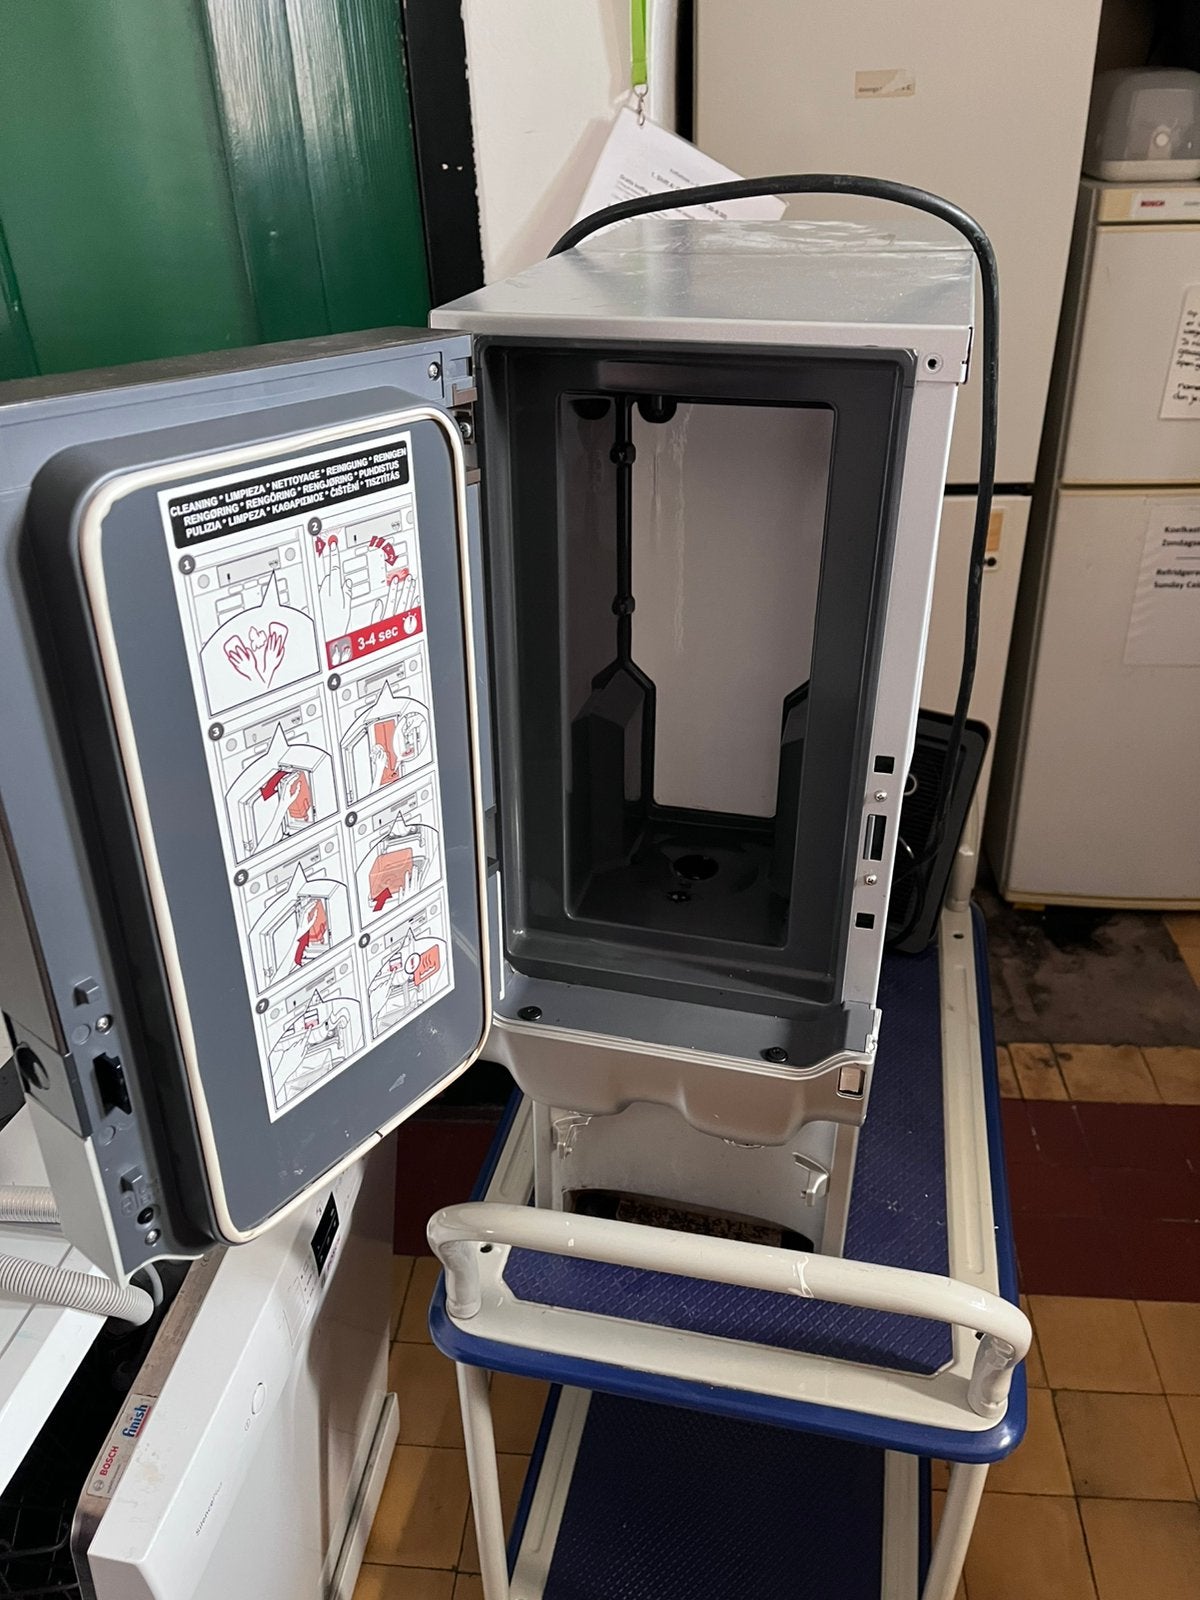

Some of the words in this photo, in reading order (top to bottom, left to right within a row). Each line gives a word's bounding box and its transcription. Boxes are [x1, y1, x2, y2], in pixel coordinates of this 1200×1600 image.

[170, 496, 219, 517] CLEANING
[224, 483, 266, 503] LIMPIEZA
[271, 469, 321, 491] NETTOYAGE
[326, 457, 368, 476] REINIGUNG
[373, 447, 407, 464] REINIGEN
[183, 503, 239, 527] RENGØRING
[245, 487, 297, 510] RENGÖRING
[302, 472, 354, 494] RENGJØRING
[358, 460, 400, 479] PUHDISTUS
[185, 520, 222, 539] PULIZIA
[228, 508, 267, 527] LIMPEZA
[329, 480, 360, 498] ČIŠTĚNÍ
[364, 470, 400, 488] TISZTÍTÁS
[357, 632, 376, 651] 3-4
[378, 625, 399, 643] sec
[121, 1404, 149, 1438] finish
[99, 1445, 120, 1477] BOSCH
